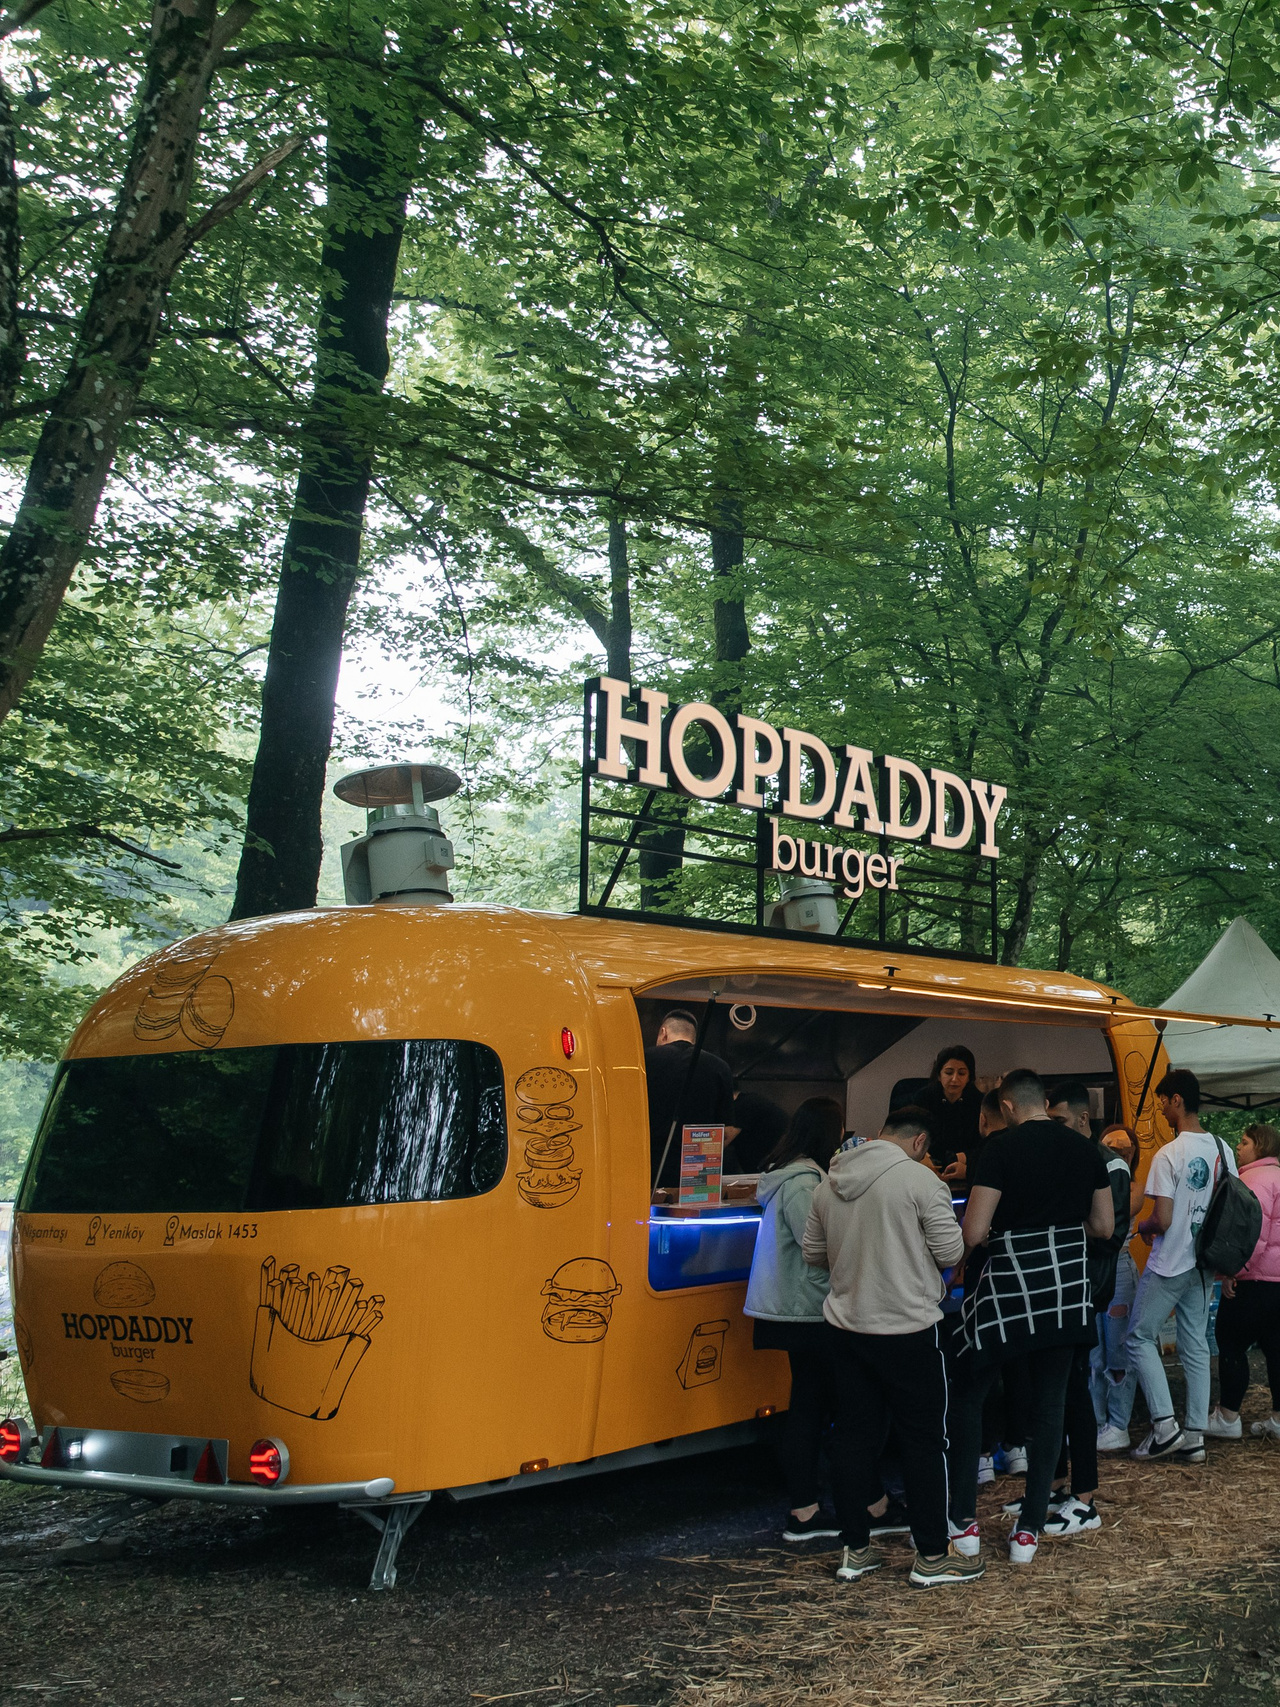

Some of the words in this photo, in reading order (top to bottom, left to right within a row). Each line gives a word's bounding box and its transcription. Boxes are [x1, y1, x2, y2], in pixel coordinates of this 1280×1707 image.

[598, 676, 1007, 858] HOPDADDY
[769, 817, 904, 898] burger
[103, 1223, 146, 1243] Yeniköy
[180, 1222, 223, 1239] Maslak
[228, 1223, 258, 1239] 1453
[61, 1312, 193, 1344] HOPDADDY
[110, 1342, 156, 1363] burger
